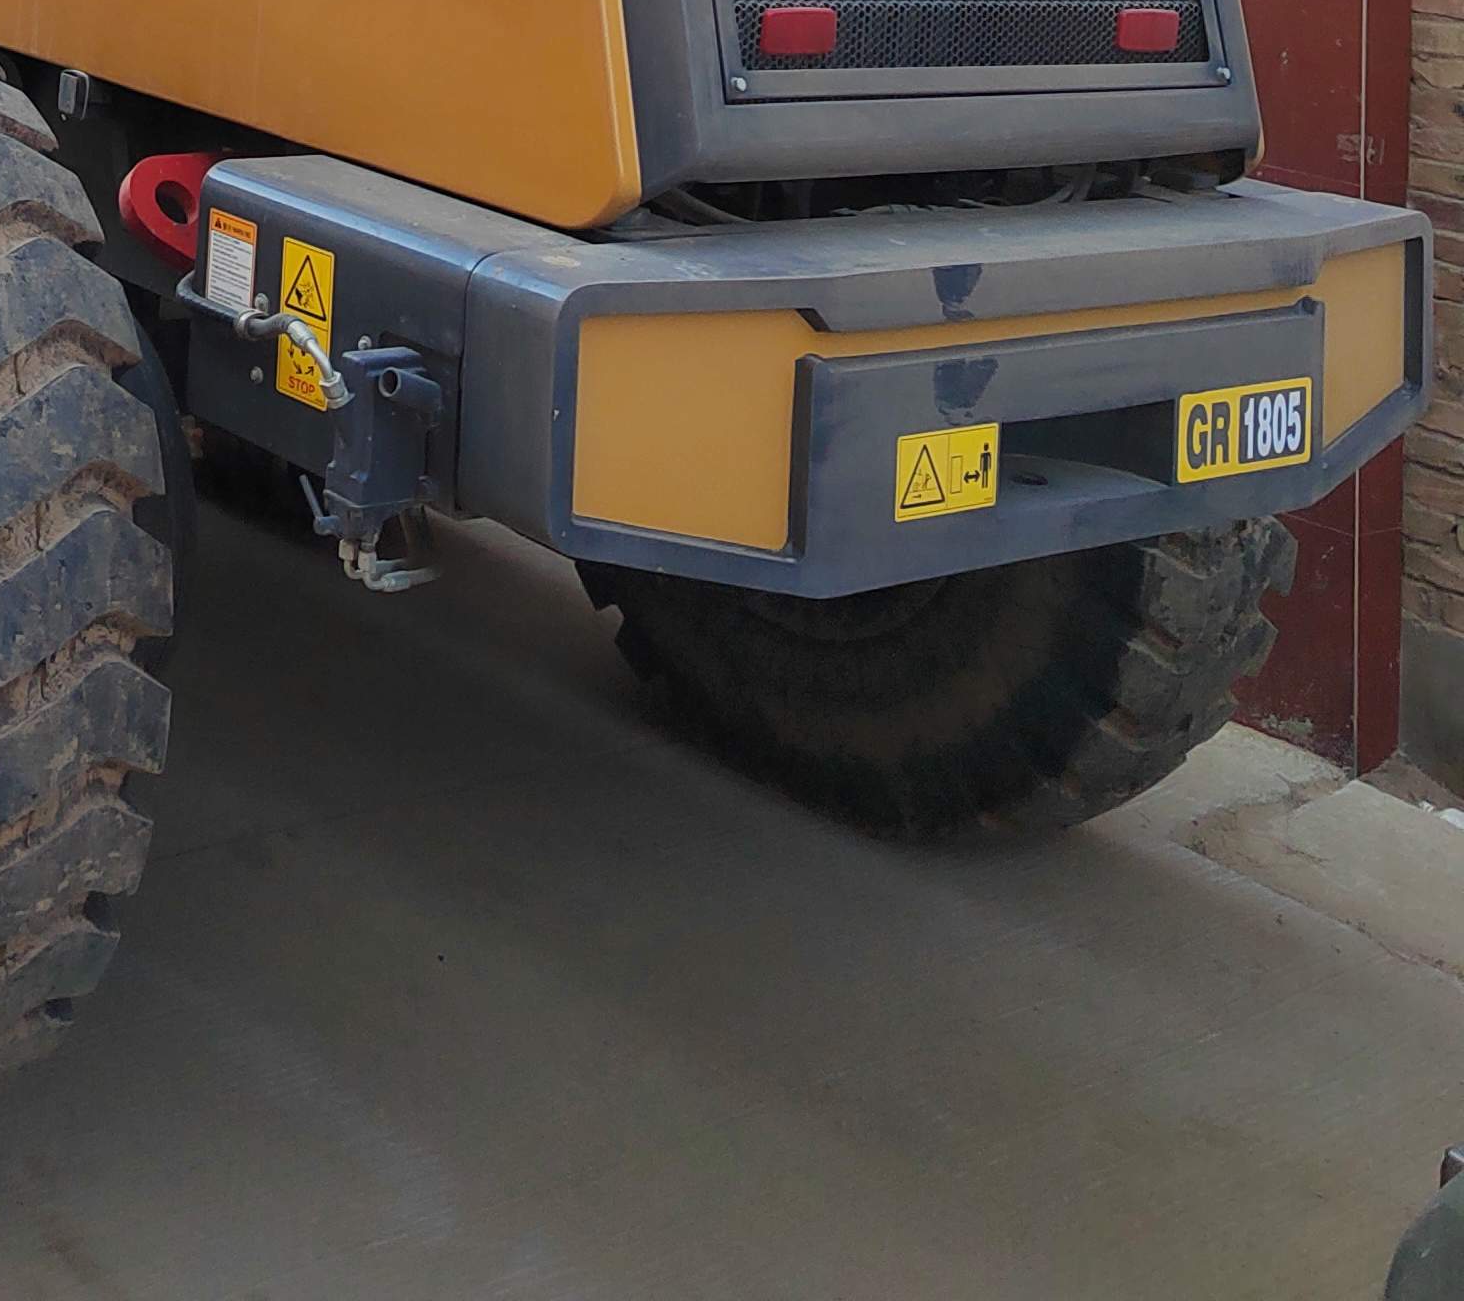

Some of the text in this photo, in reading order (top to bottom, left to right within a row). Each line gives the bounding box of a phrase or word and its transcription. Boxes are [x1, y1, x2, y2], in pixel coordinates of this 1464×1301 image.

[288, 375, 316, 394] STOP
[1185, 391, 1303, 470] GR 1805
